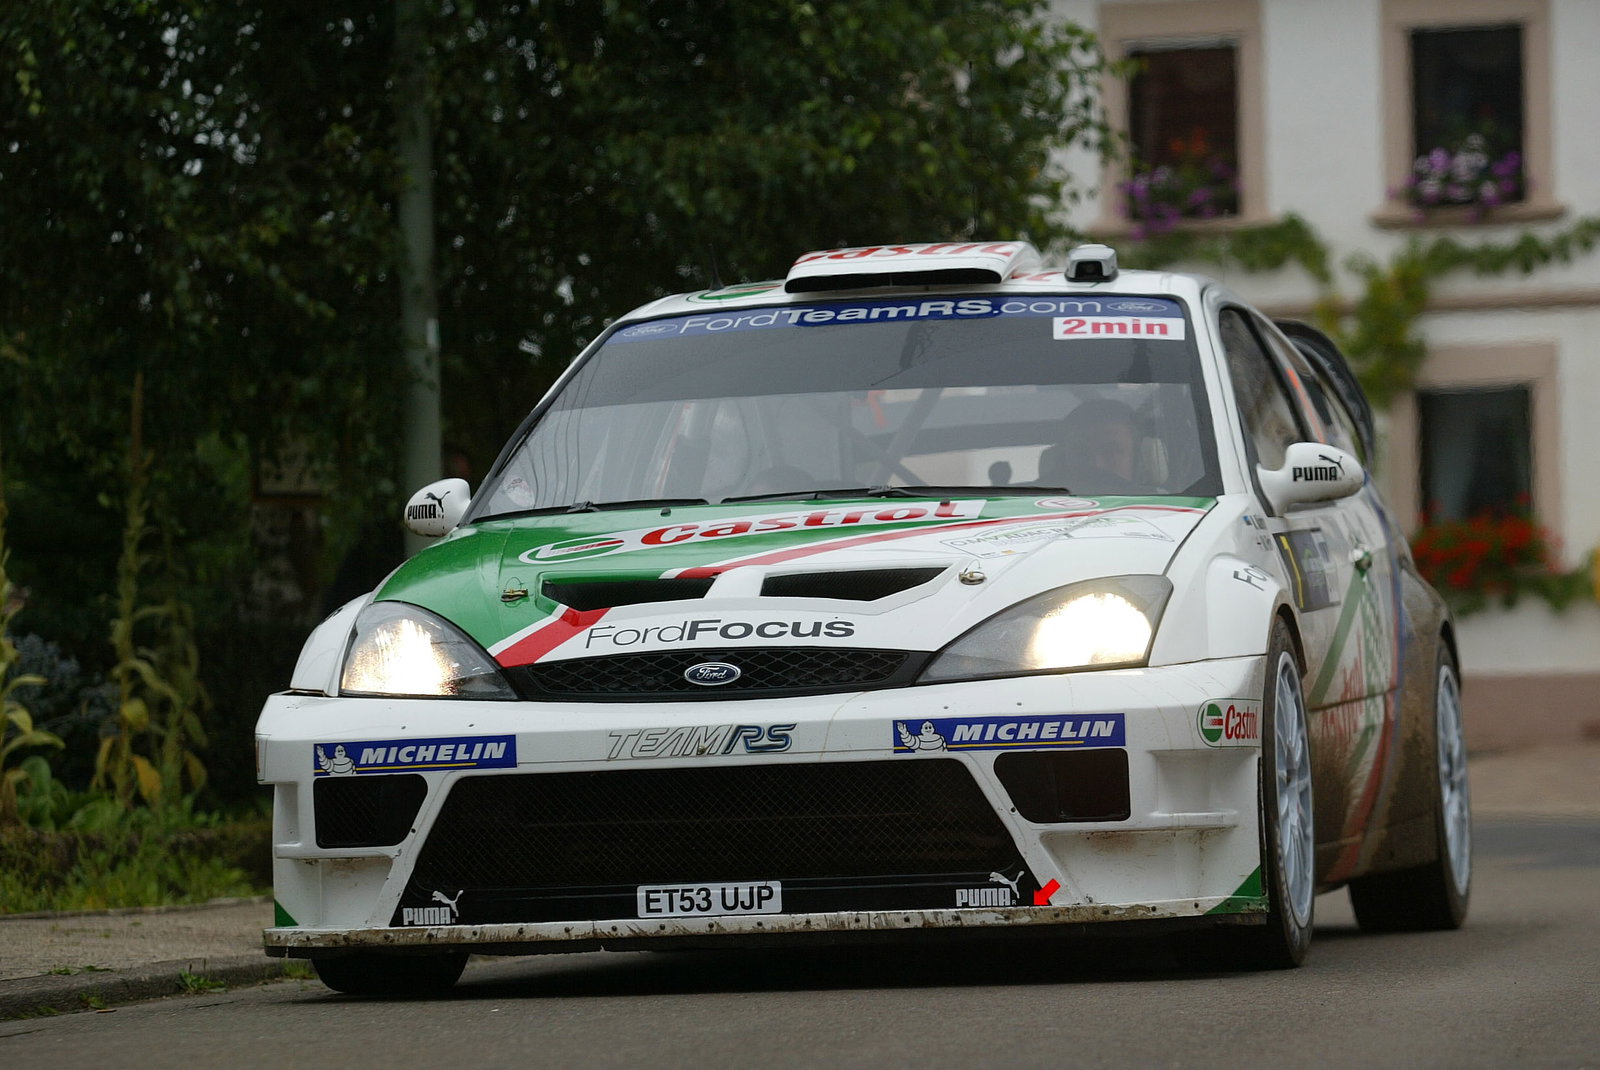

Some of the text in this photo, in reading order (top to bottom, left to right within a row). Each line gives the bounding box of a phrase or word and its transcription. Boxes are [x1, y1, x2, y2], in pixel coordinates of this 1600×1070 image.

[679, 300, 1102, 334] FordTeamRS.com
[1062, 318, 1168, 335] 2min
[1292, 466, 1337, 482] PUMA
[407, 503, 437, 520] PUMA
[641, 502, 966, 545] Castrol
[696, 666, 727, 680] Ford
[952, 720, 1116, 742] MICHELIN
[1225, 704, 1258, 740] Castrol
[359, 742, 507, 765] MICHELIN
[645, 885, 774, 914] ET53 UJP
[955, 887, 1011, 907] PUMA
[402, 907, 451, 926] PUMA
